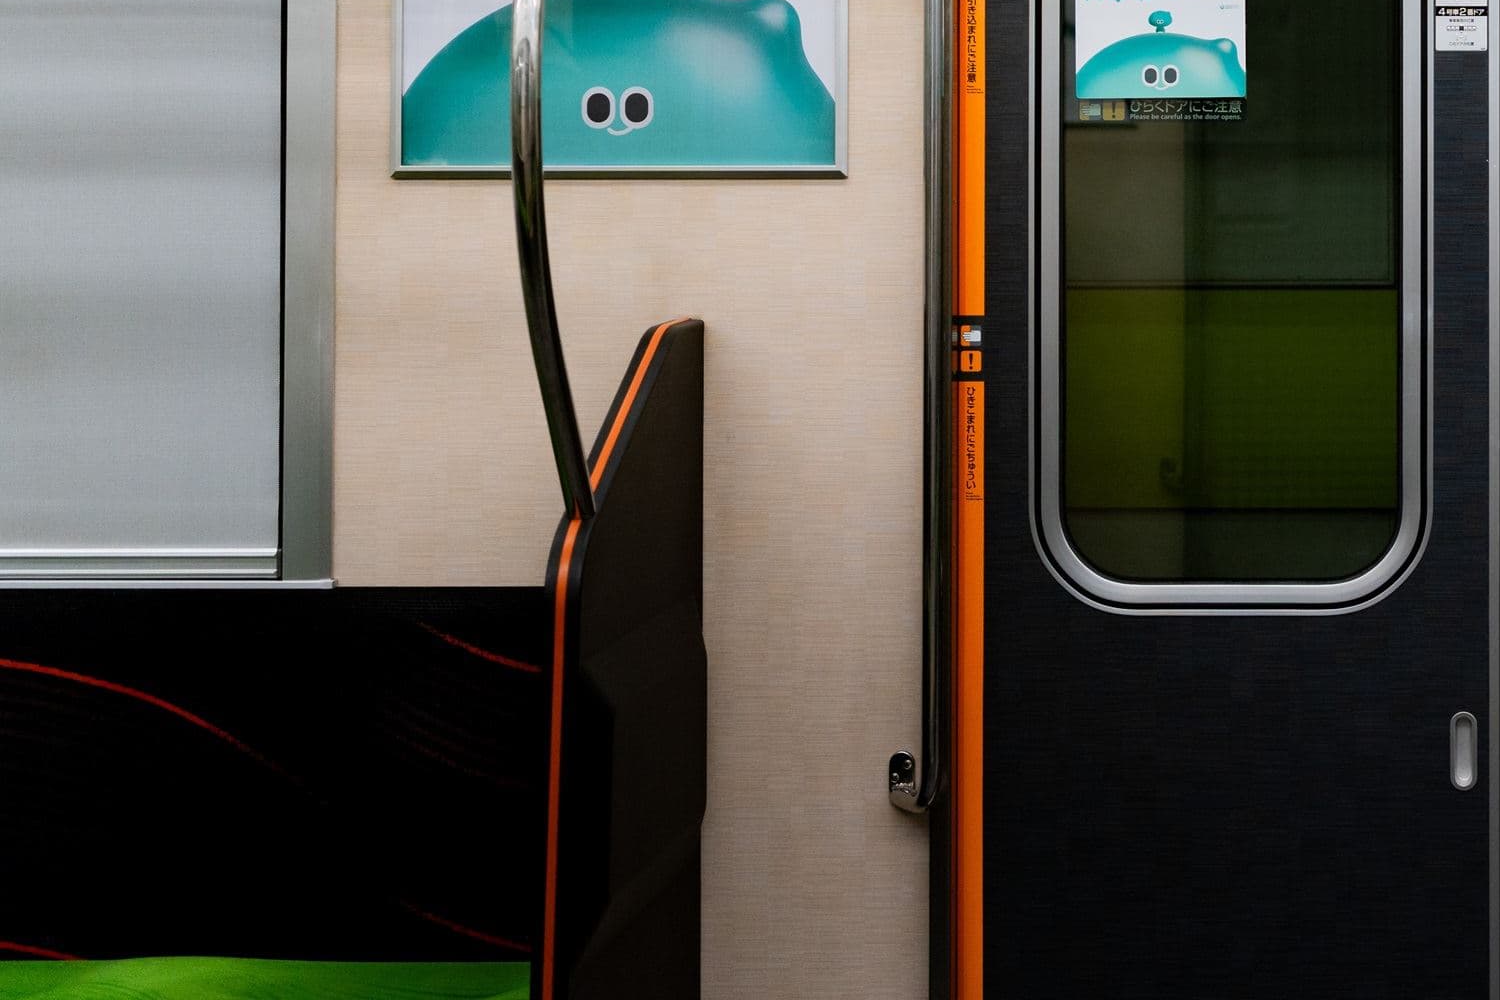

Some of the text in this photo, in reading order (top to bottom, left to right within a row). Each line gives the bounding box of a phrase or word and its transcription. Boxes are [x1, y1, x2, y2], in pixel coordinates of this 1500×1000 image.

[1130, 100, 1242, 113] ひらくドアにご注意
[1221, 113, 1241, 121] opens.
[966, 386, 976, 490] ひきこまれにごちゅうい
